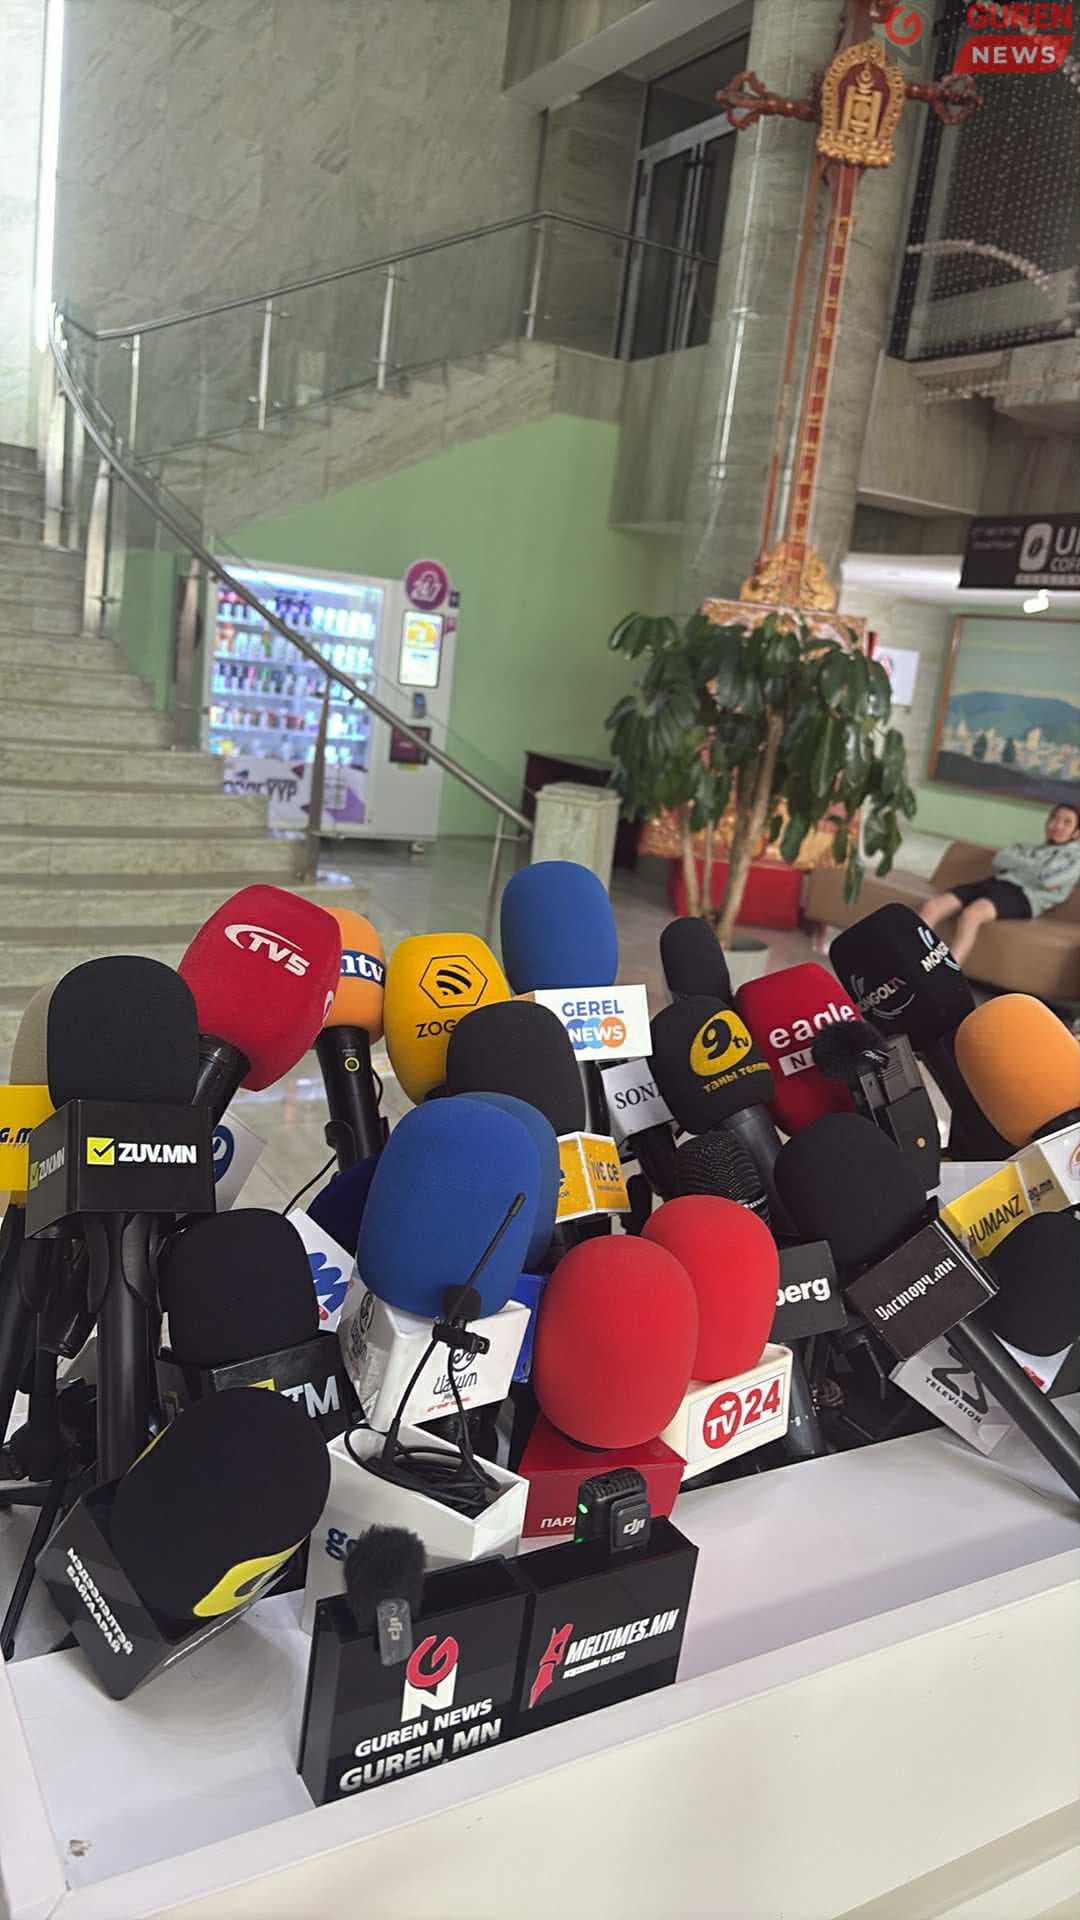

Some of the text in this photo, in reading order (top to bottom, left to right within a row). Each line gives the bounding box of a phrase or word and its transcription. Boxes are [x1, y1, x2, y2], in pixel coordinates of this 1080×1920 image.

[1055, 526, 1080, 556] U
[248, 932, 310, 977] TV5
[561, 999, 625, 1017] GEREL
[568, 1024, 623, 1043] NEWS
[118, 1142, 198, 1164] ZUV.MN
[743, 1379, 781, 1426] 24
[924, 1376, 984, 1424] TELEVISION
[65, 1564, 121, 1654] БАЙГААРАЙ
[66, 1547, 134, 1655] МЭДЭЭЛЭЛТЭЙ
[564, 1608, 680, 1666] MGLTIMES.MN
[354, 1698, 493, 1757] GUREN NEWS
